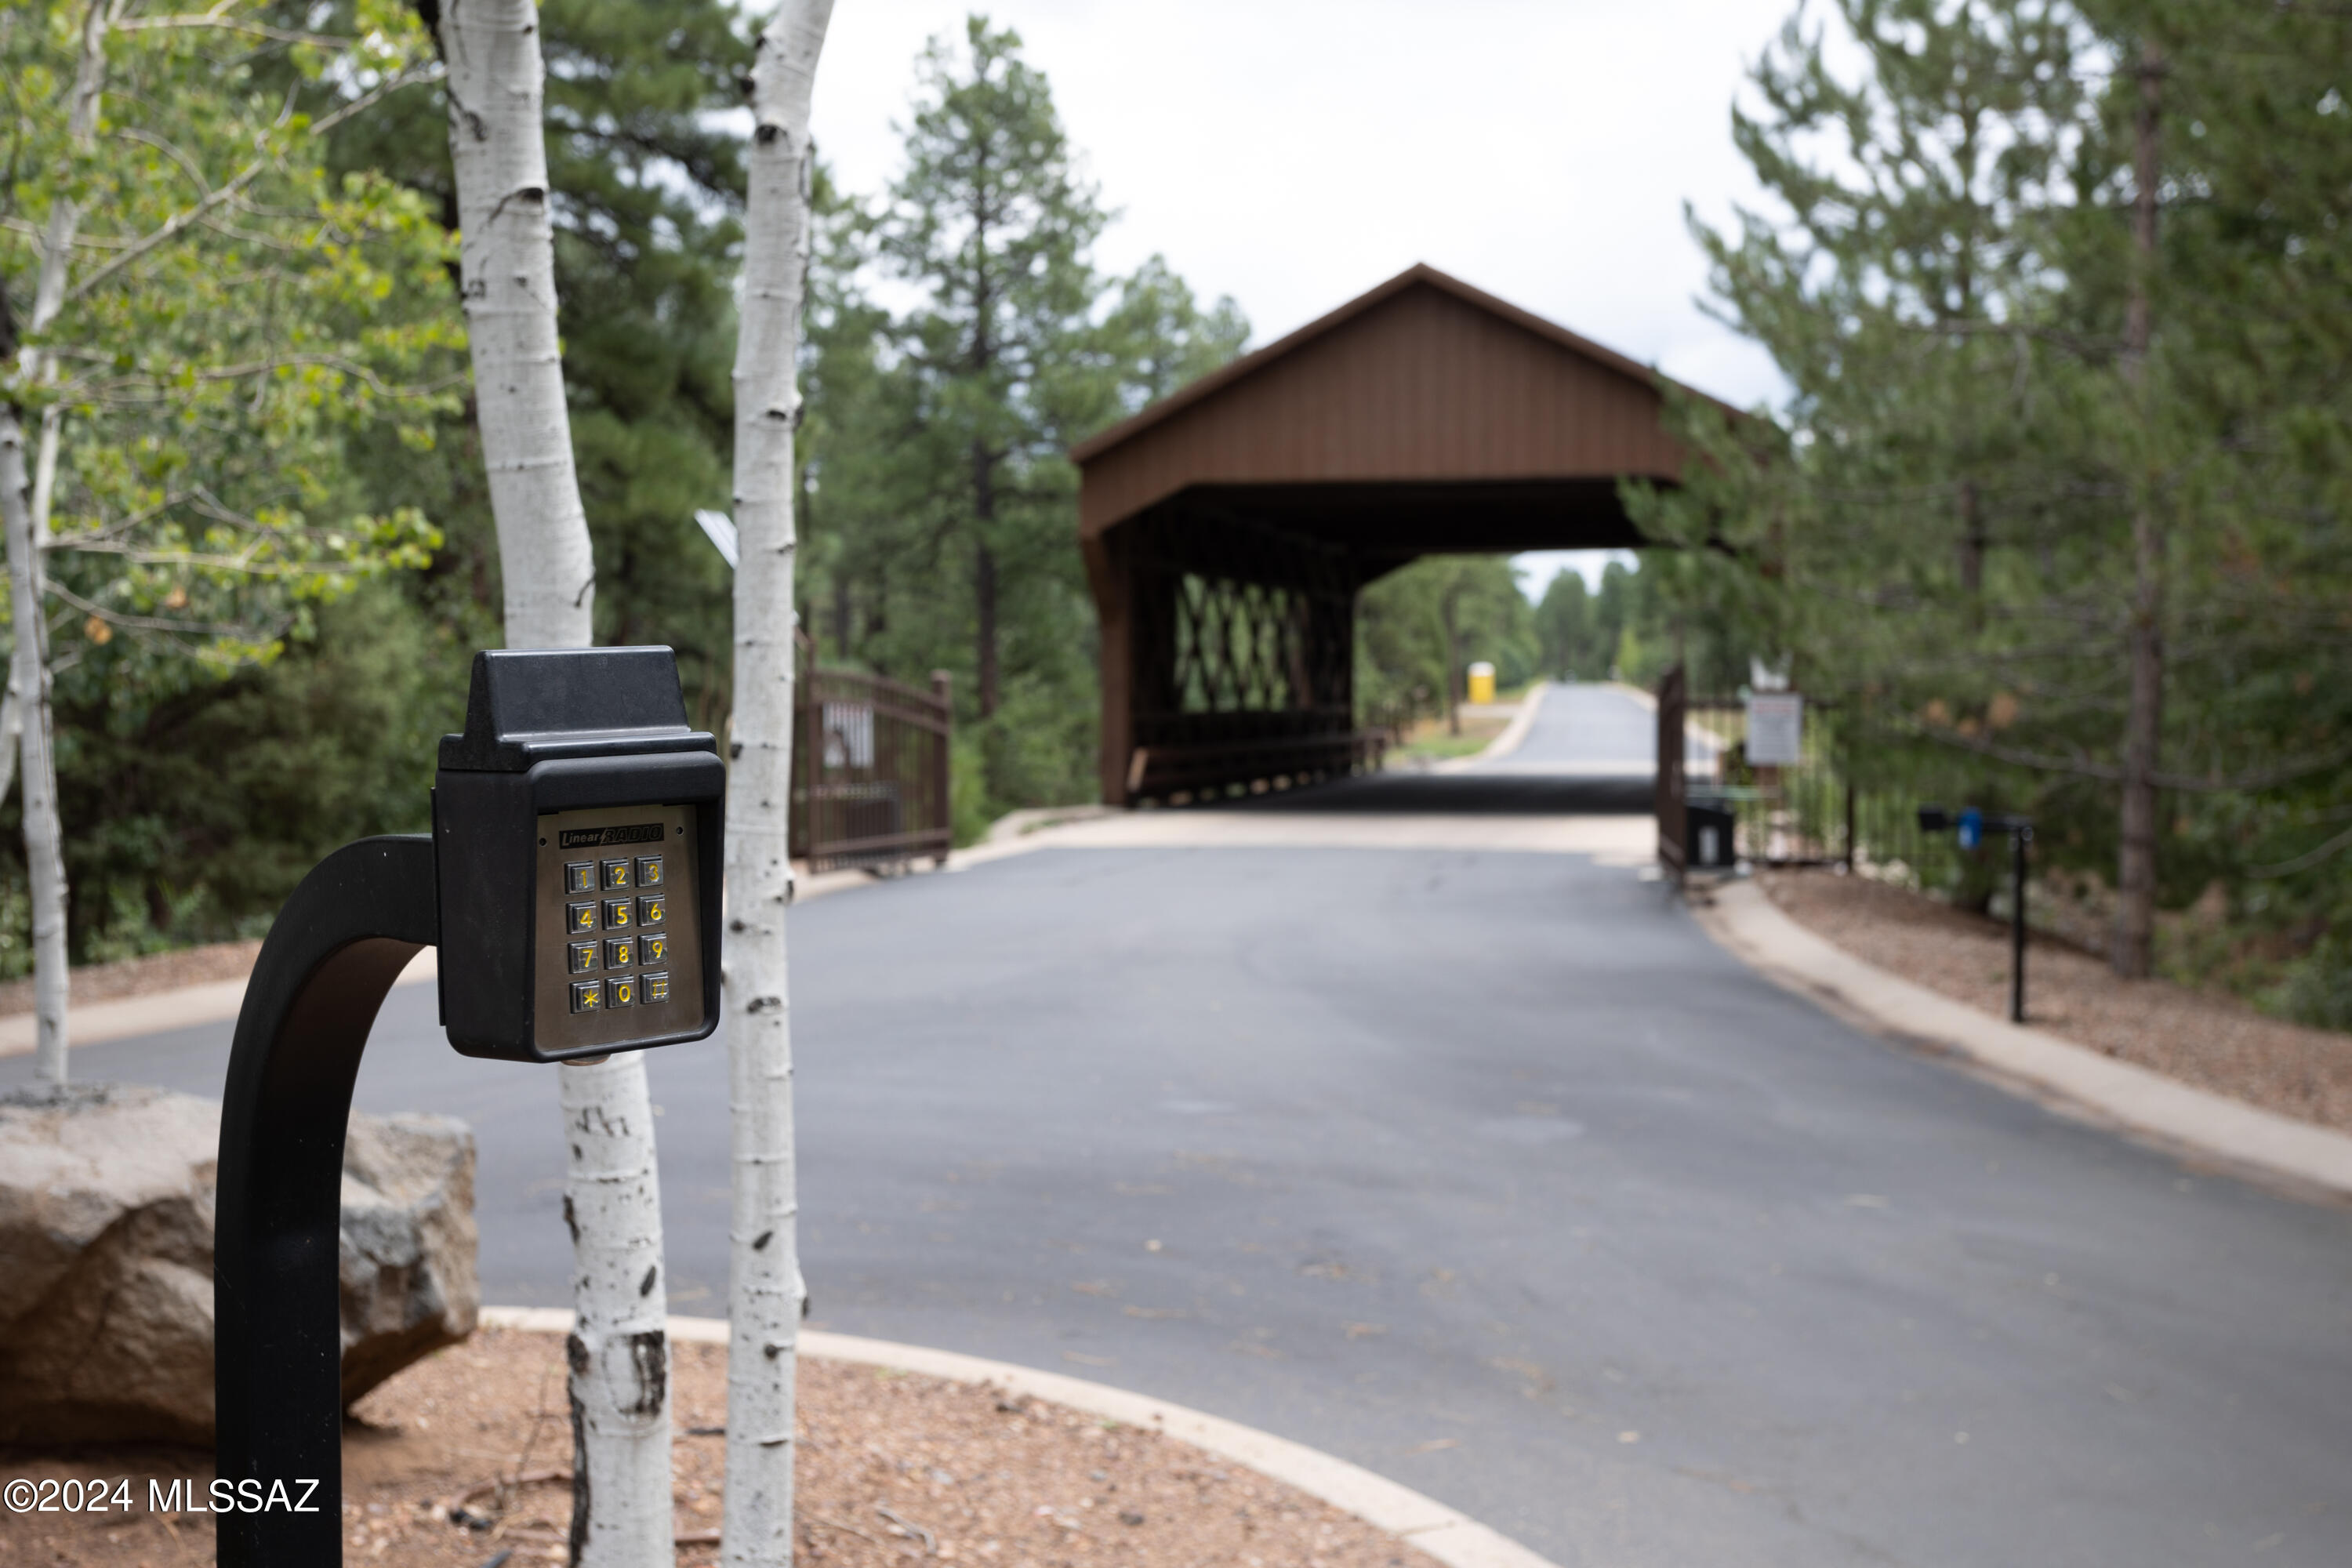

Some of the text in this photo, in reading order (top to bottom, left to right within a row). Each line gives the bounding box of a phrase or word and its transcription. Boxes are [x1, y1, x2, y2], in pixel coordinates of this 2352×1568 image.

[561, 825, 662, 847] Linear RADIO
[580, 863, 659, 888] 1 2 3
[579, 902, 662, 928] 4 5 6
[582, 941, 663, 967] 7 8 9
